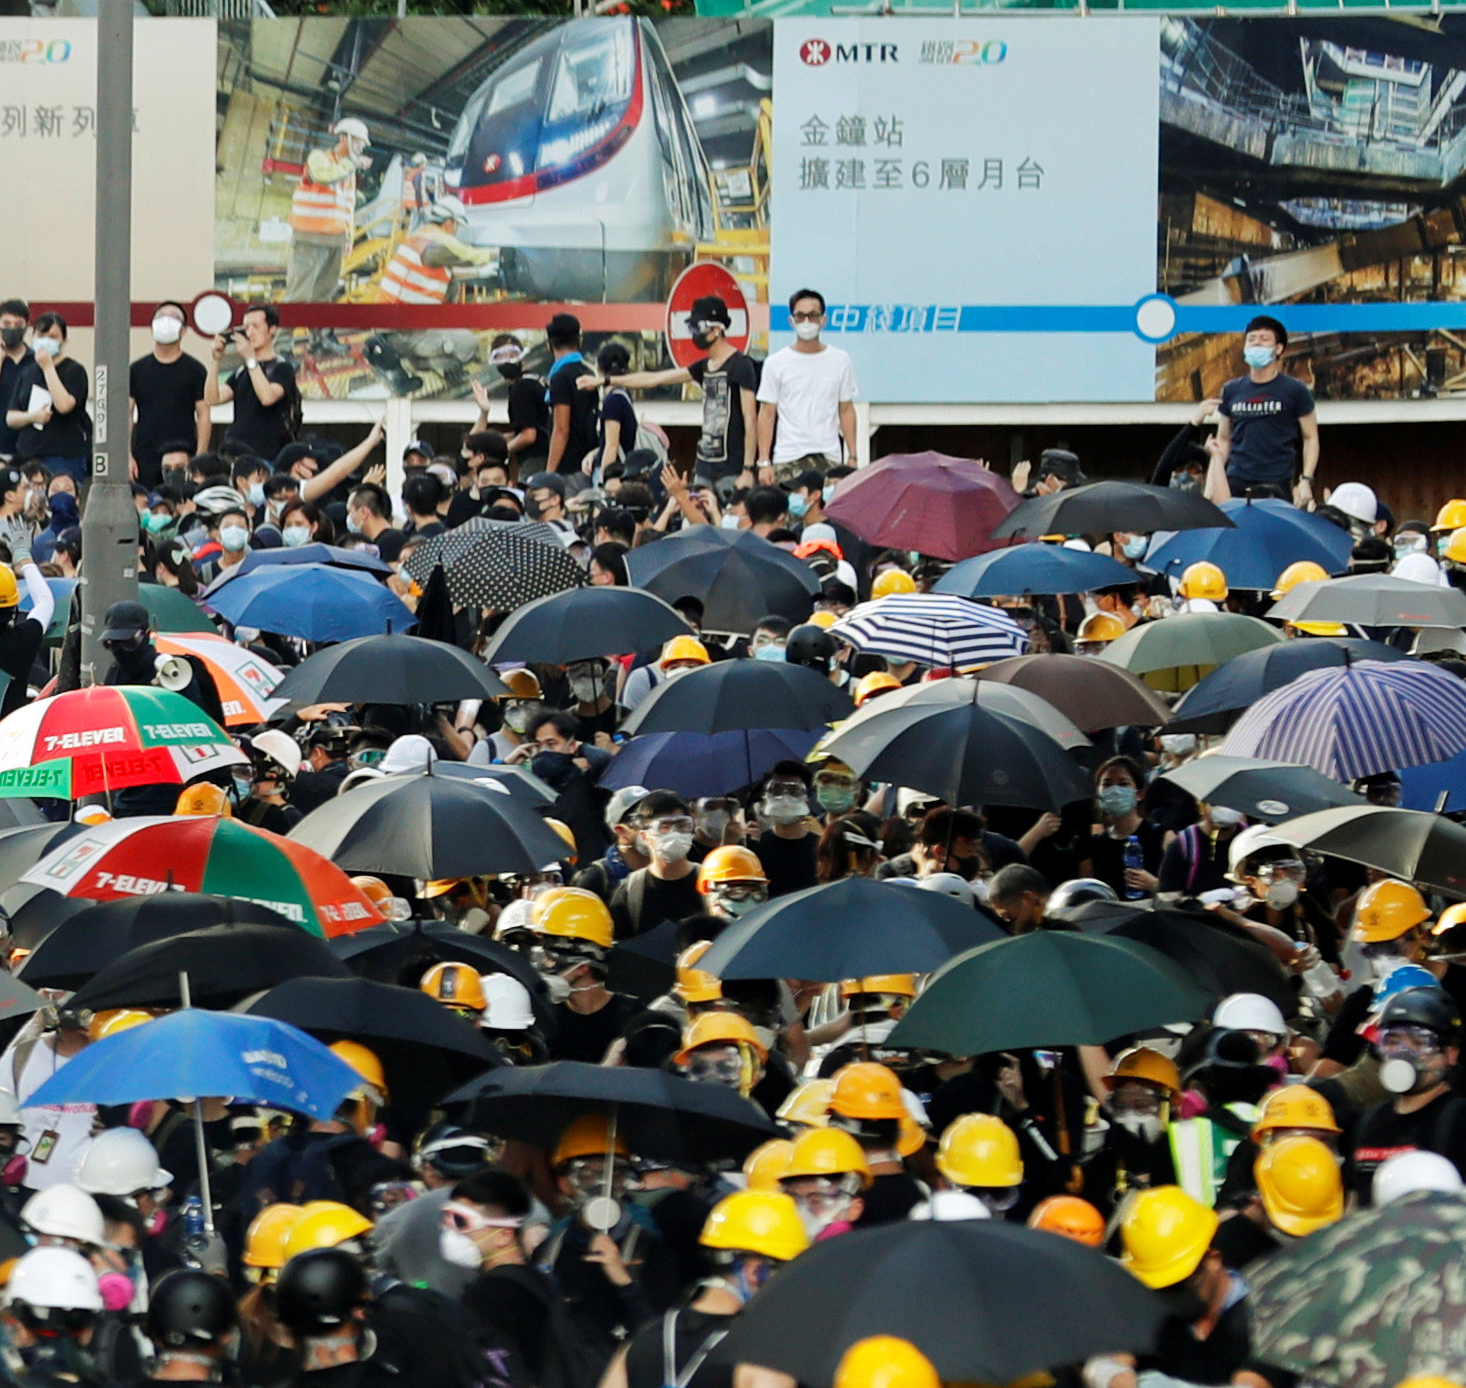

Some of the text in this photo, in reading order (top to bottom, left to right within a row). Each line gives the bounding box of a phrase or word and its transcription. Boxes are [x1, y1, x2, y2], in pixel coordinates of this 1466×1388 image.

[836, 43, 899, 63] MTR
[800, 114, 905, 148] 金鐘站
[799, 156, 1046, 191] 擴建至6層月台
[830, 304, 963, 333] 中綫項目
[95, 455, 106, 474] B
[44, 722, 212, 751] 7-ELEVEN 7-ELEVEN
[97, 871, 181, 895] 7-ELEV
